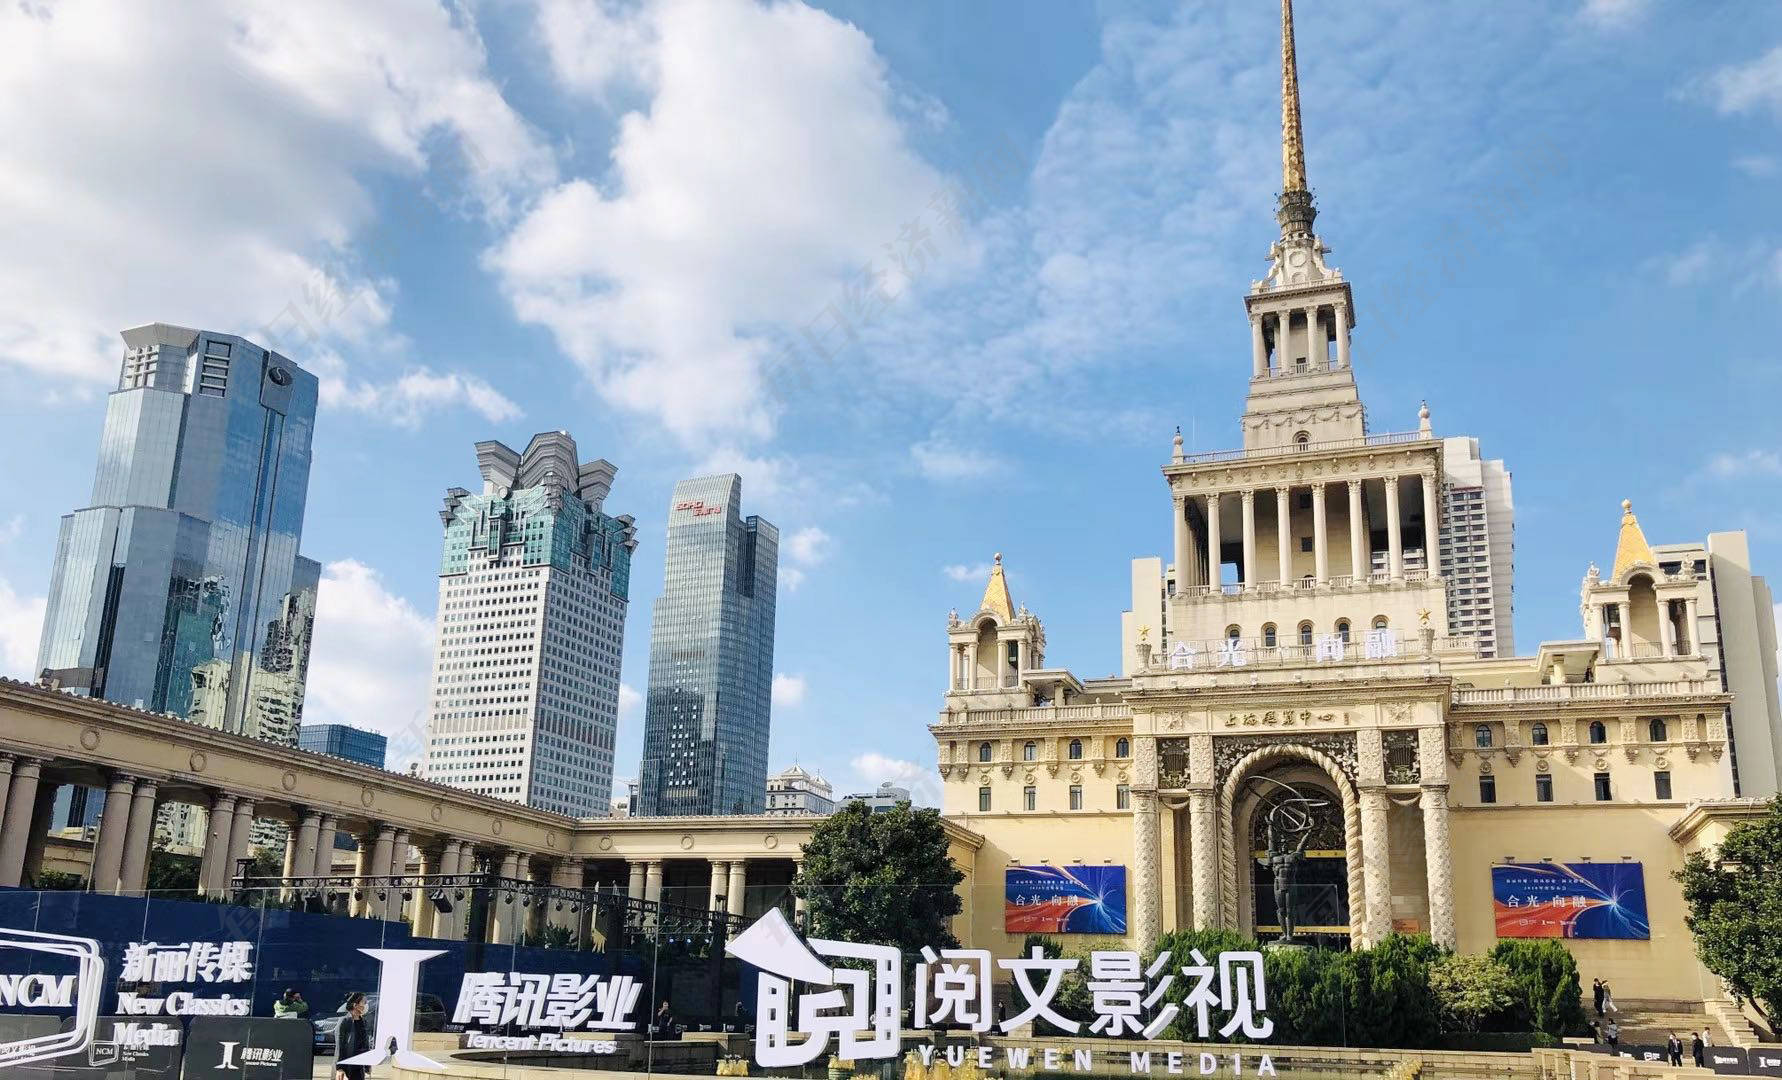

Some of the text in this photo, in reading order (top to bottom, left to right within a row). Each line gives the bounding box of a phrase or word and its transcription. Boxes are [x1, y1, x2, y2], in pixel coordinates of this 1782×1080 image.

[120, 941, 253, 983] 新丽传媒
[0, 973, 77, 1007] NCM
[115, 991, 251, 1016] New Classics
[451, 971, 643, 1030] 腾讯影业
[914, 945, 1275, 1040] 阅文影视
[113, 1022, 179, 1047] Media
[465, 1029, 617, 1055] Tencent Pictures
[918, 1044, 1278, 1078] YUEWEN MEDIA
